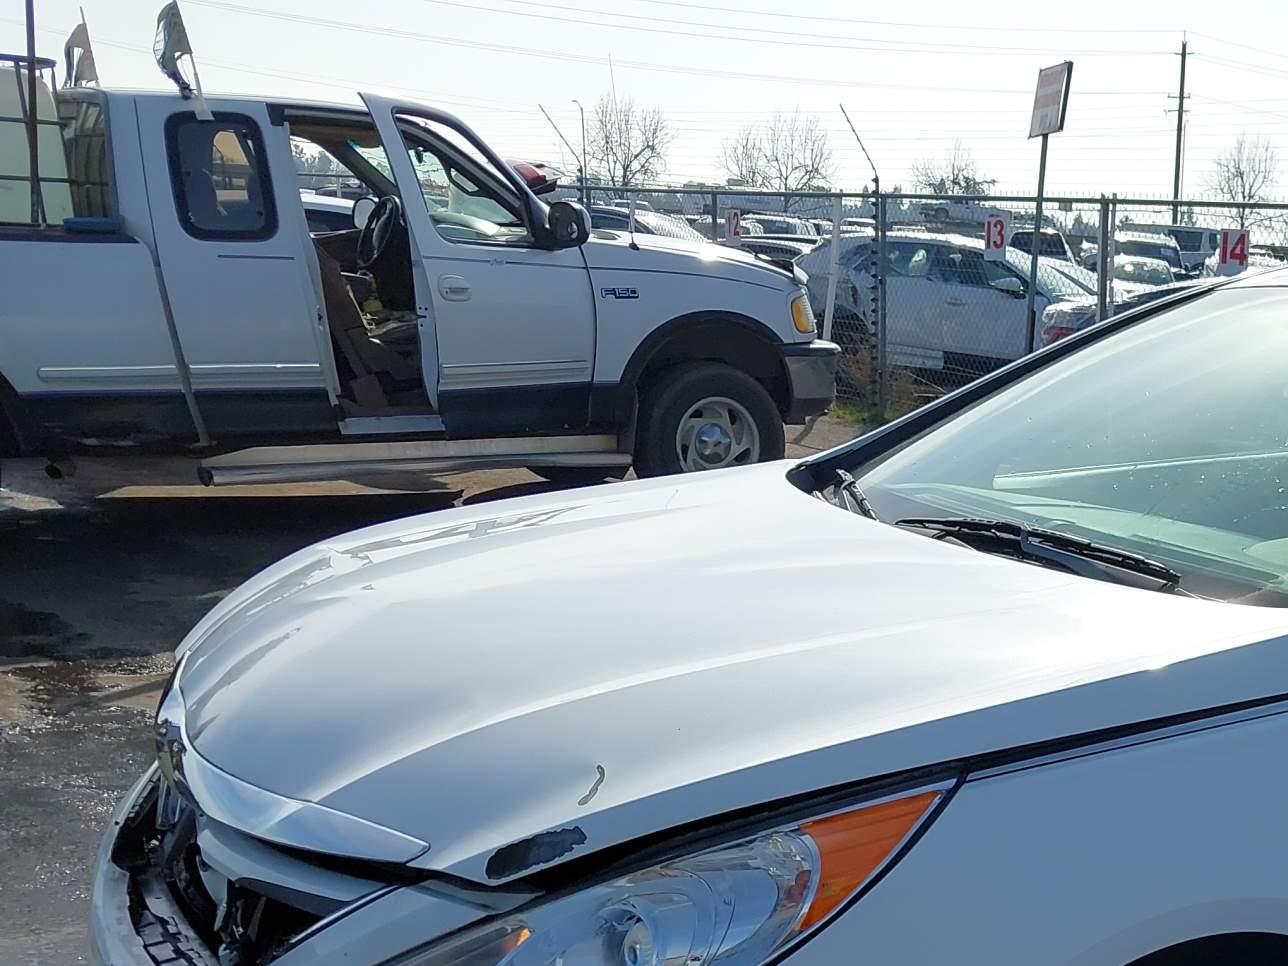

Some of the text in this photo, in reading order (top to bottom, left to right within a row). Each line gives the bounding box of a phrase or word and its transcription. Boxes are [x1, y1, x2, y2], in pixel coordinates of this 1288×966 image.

[727, 211, 740, 237] 12
[986, 219, 1005, 249] 13
[1221, 231, 1248, 266] 14
